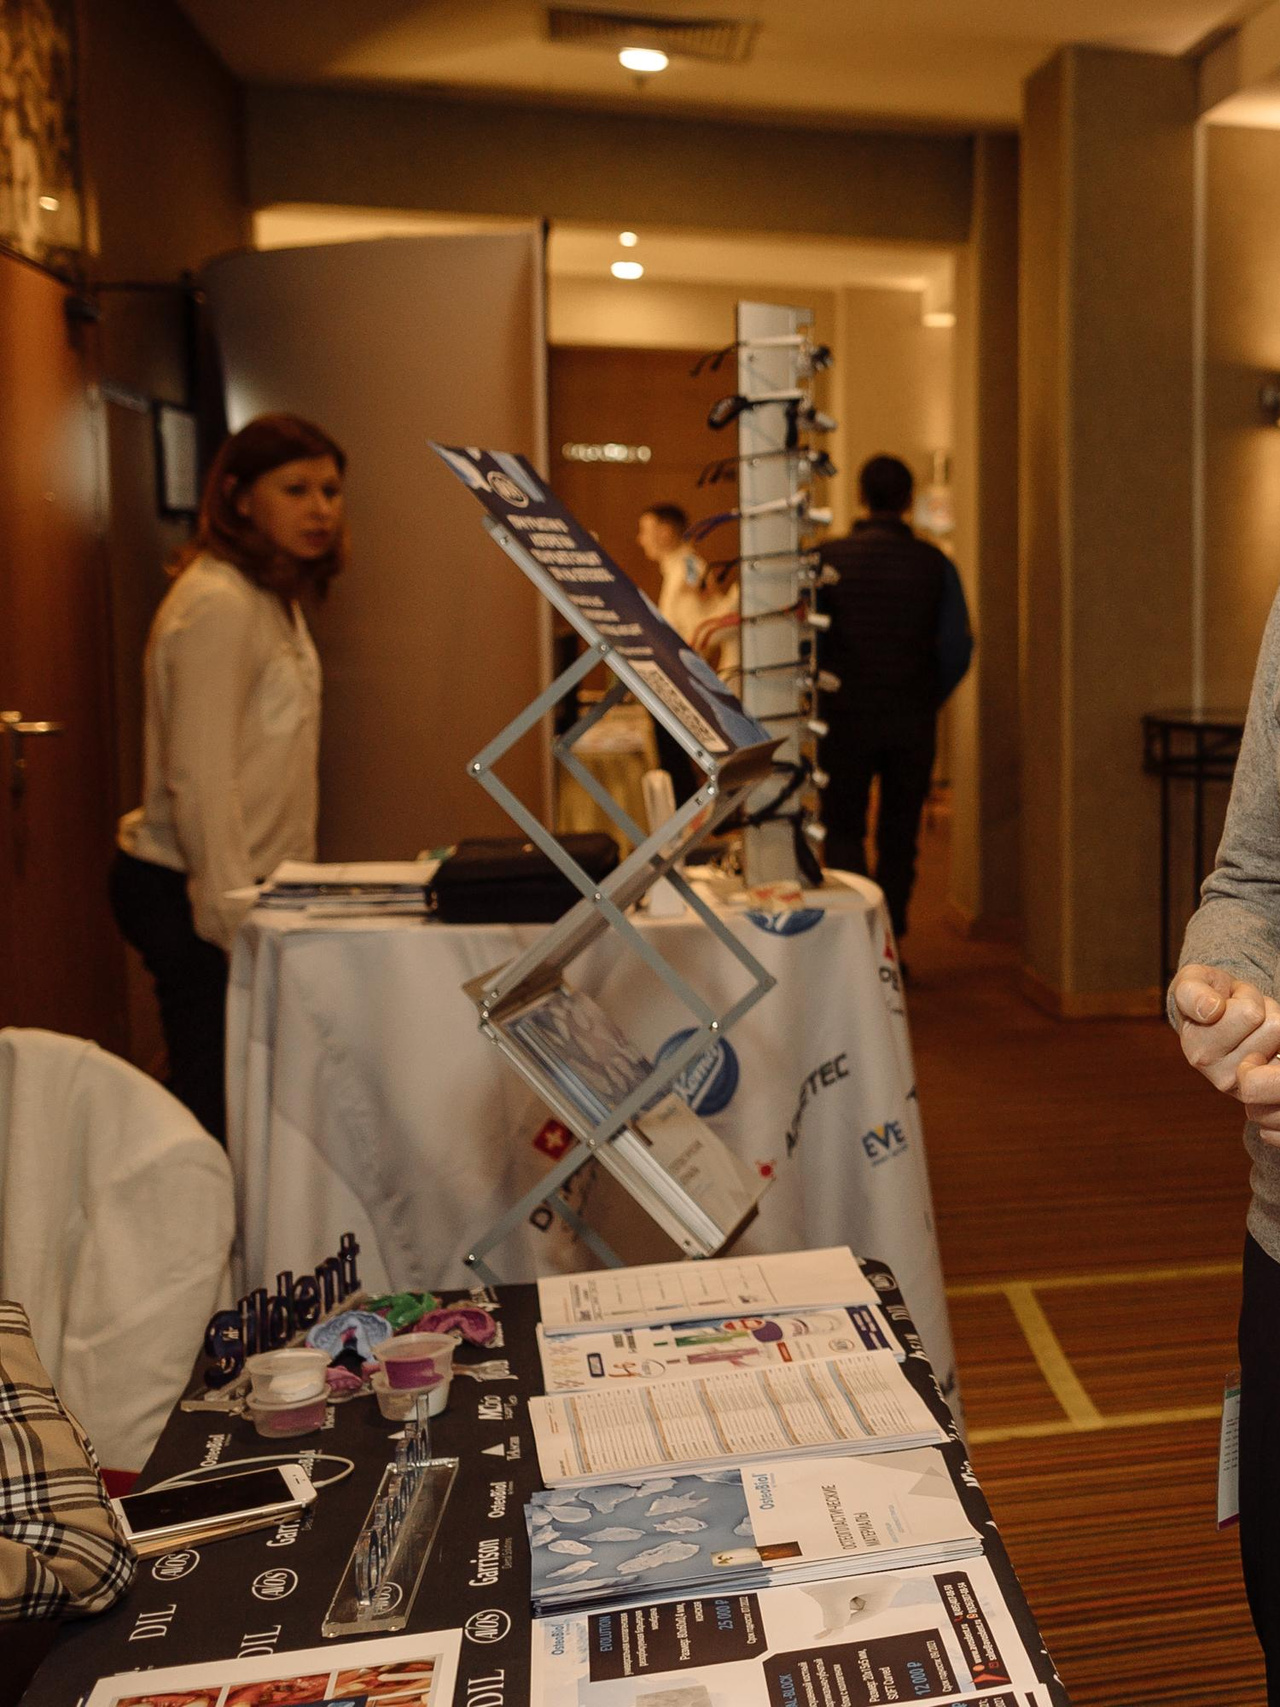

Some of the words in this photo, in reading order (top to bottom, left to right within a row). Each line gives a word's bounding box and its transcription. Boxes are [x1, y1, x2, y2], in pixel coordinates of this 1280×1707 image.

[862, 1120, 905, 1158] EVE
[488, 1481, 507, 1518] OsteoBiol
[754, 1474, 774, 1510] OsteoBiol
[266, 1518, 299, 1548] Garr
[821, 1485, 857, 1551] ОСТЕОПЛАСТИЧЕСКИЕ
[854, 1511, 881, 1547] МАТЕРИАЛЫ
[468, 1538, 500, 1586] Garrison
[129, 1604, 177, 1641] DIL
[717, 1606, 731, 1619] 000
[719, 1620, 732, 1630] 25
[237, 1625, 281, 1659] DIL
[551, 1624, 563, 1655] OsteoBiol
[600, 1616, 612, 1652] EVOLUTION
[746, 1631, 757, 1644] Срок
[961, 1624, 980, 1663] www.avosdent.ru
[879, 1666, 894, 1685] Curved
[909, 1669, 926, 1684] 000
[914, 1684, 930, 1695] 12
[942, 1680, 953, 1693] Срок
[886, 1685, 900, 1700] SOFT
